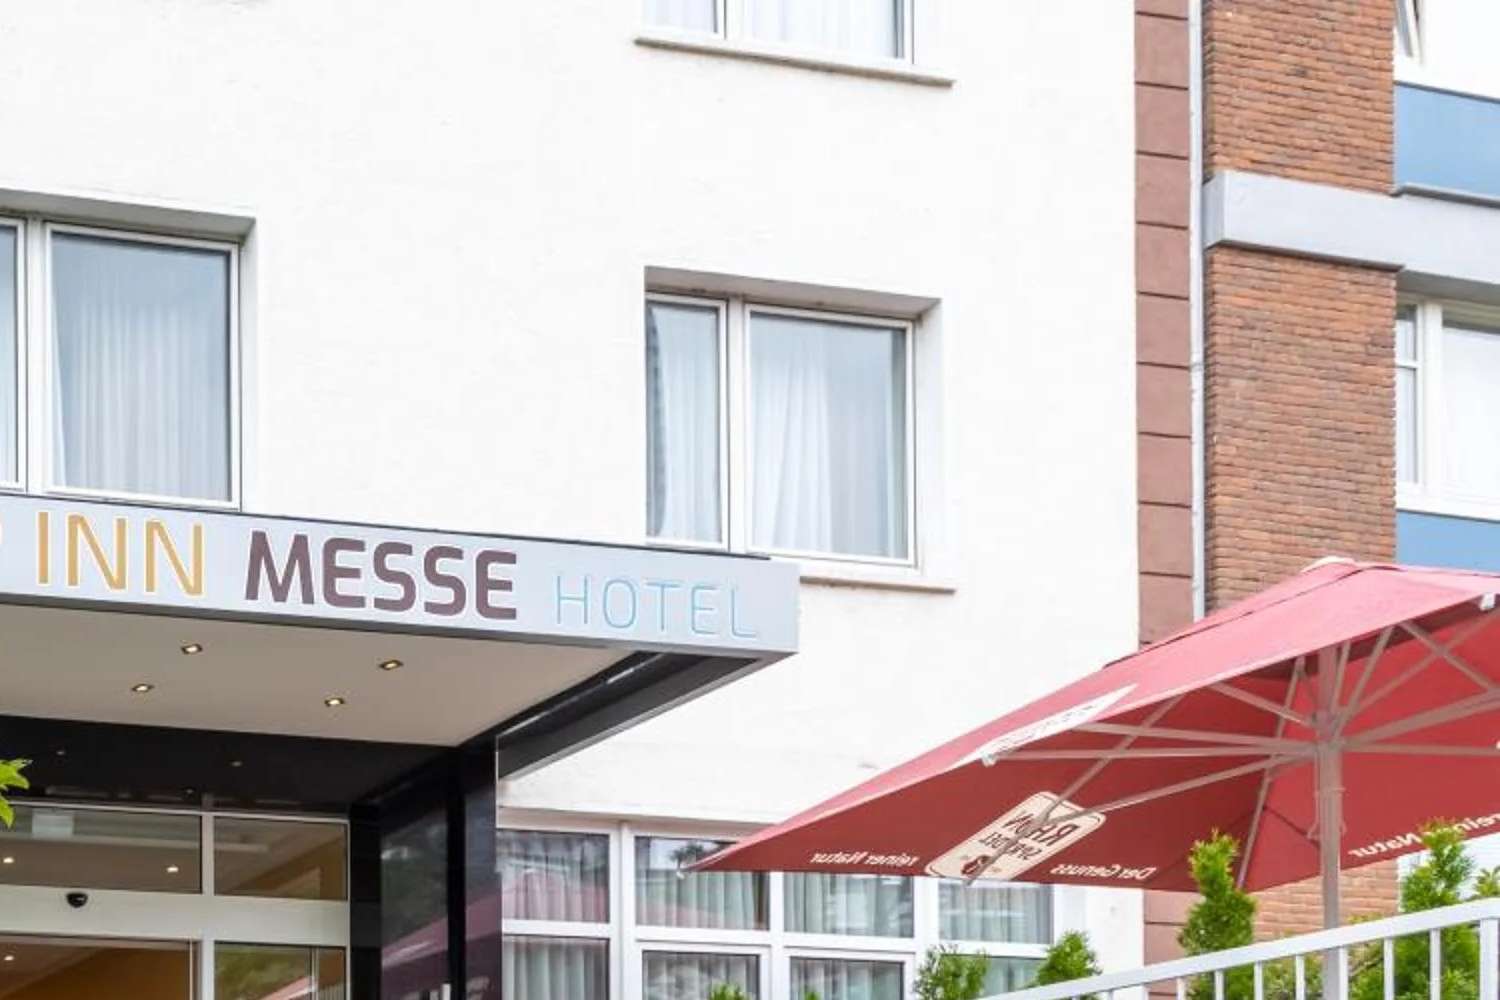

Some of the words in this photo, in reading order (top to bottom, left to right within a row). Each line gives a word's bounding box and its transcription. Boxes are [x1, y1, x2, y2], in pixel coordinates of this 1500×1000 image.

[37, 510, 204, 597] INN
[244, 530, 518, 620] MESSE
[556, 574, 759, 639] HOTEL
